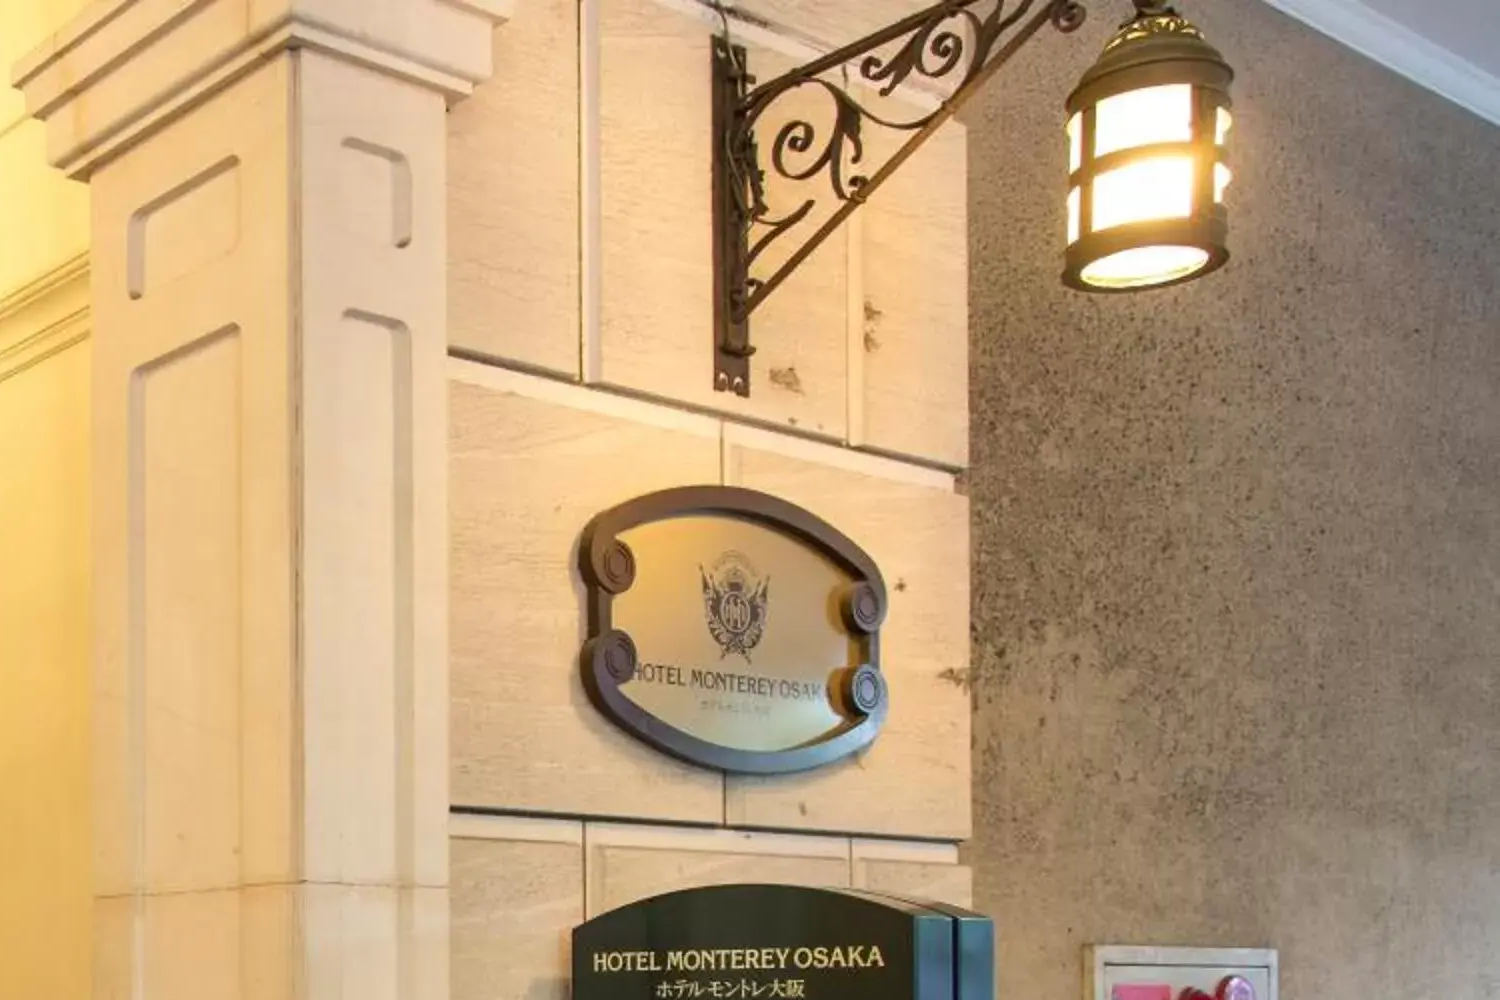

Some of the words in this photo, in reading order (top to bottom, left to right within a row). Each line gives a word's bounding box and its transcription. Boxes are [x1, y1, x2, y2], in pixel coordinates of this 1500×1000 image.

[689, 669, 776, 698] MONTEREY
[779, 679, 822, 702] OSAK
[593, 951, 662, 973] HOTEL
[666, 948, 790, 971] MONTEREY
[793, 945, 885, 969] OSAKA
[656, 978, 805, 999] ホテルモントレ大阪
